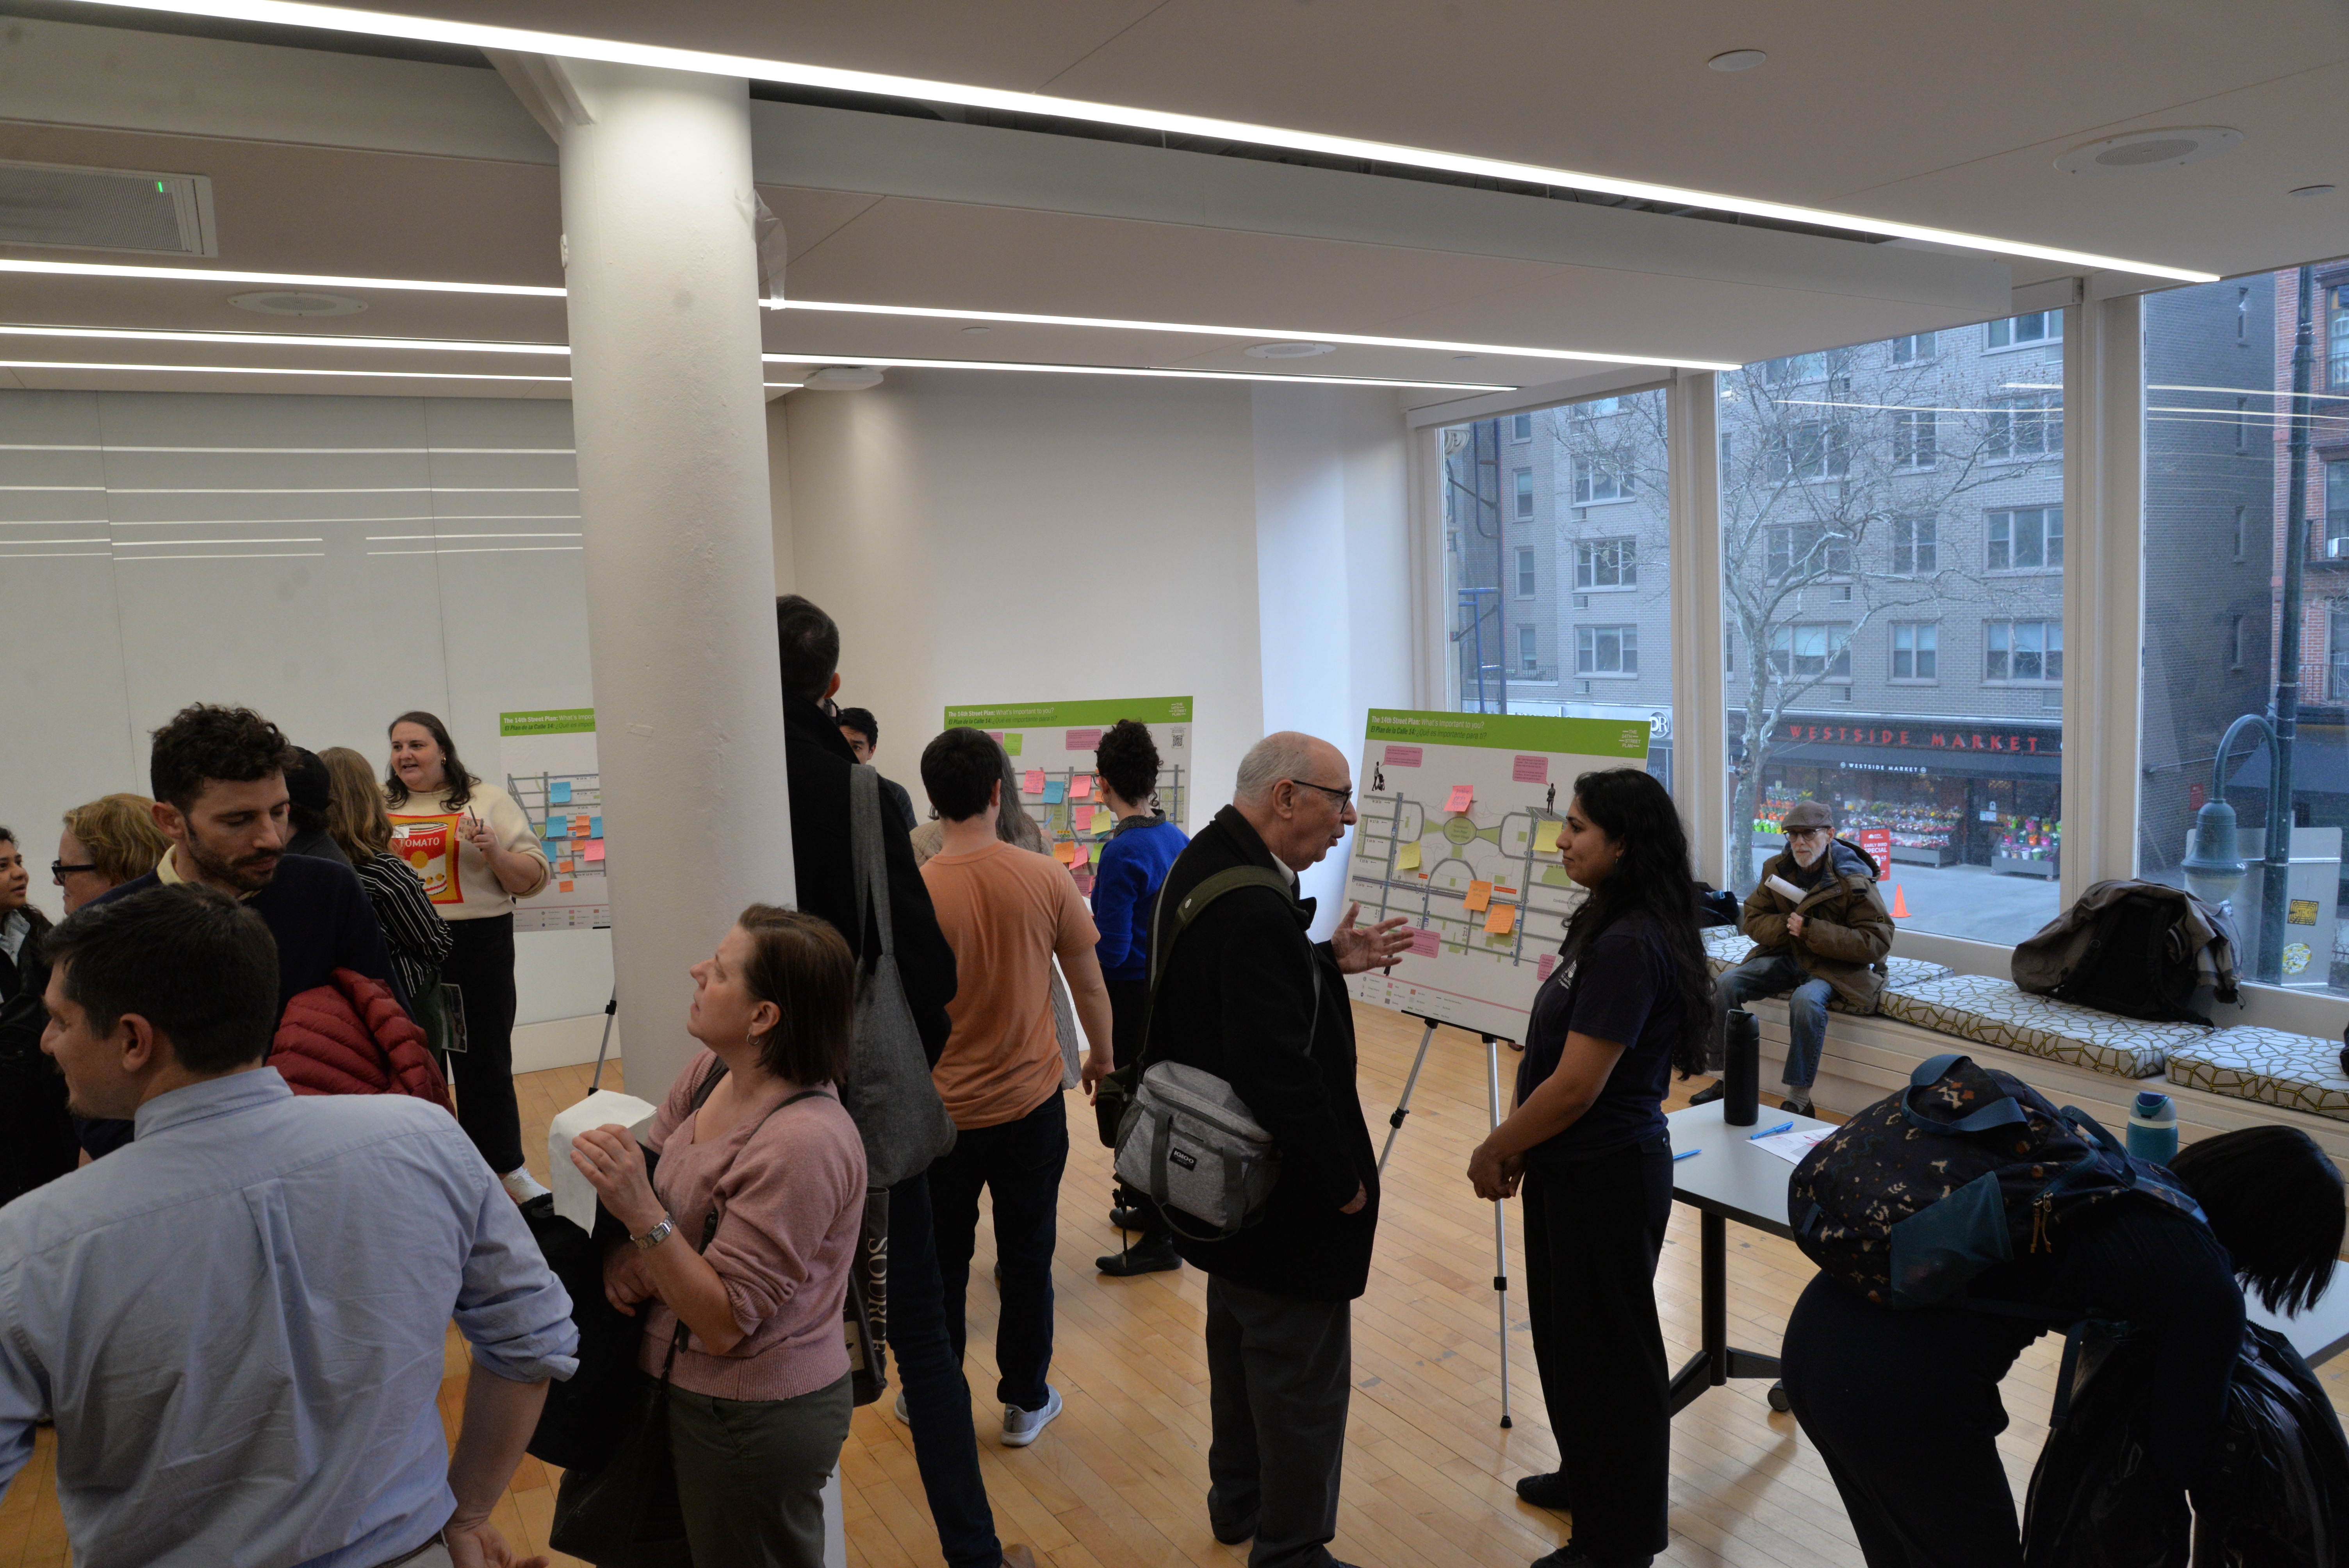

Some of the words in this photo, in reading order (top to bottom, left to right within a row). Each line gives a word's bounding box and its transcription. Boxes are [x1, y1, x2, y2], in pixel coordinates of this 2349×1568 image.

[992, 716, 1005, 725] ¿Qué
[1012, 716, 1038, 724] importante
[1421, 718, 1438, 727] What's
[1439, 720, 1464, 729] Important
[1471, 722, 1484, 730] you?
[1416, 729, 1430, 737] ¿Qué
[1437, 730, 1465, 739] importante
[1790, 725, 1908, 745] WESTSIDE
[1931, 732, 2038, 752] MARKET
[398, 837, 440, 847] TOMATO
[1174, 1150, 1194, 1164] IGLOO
